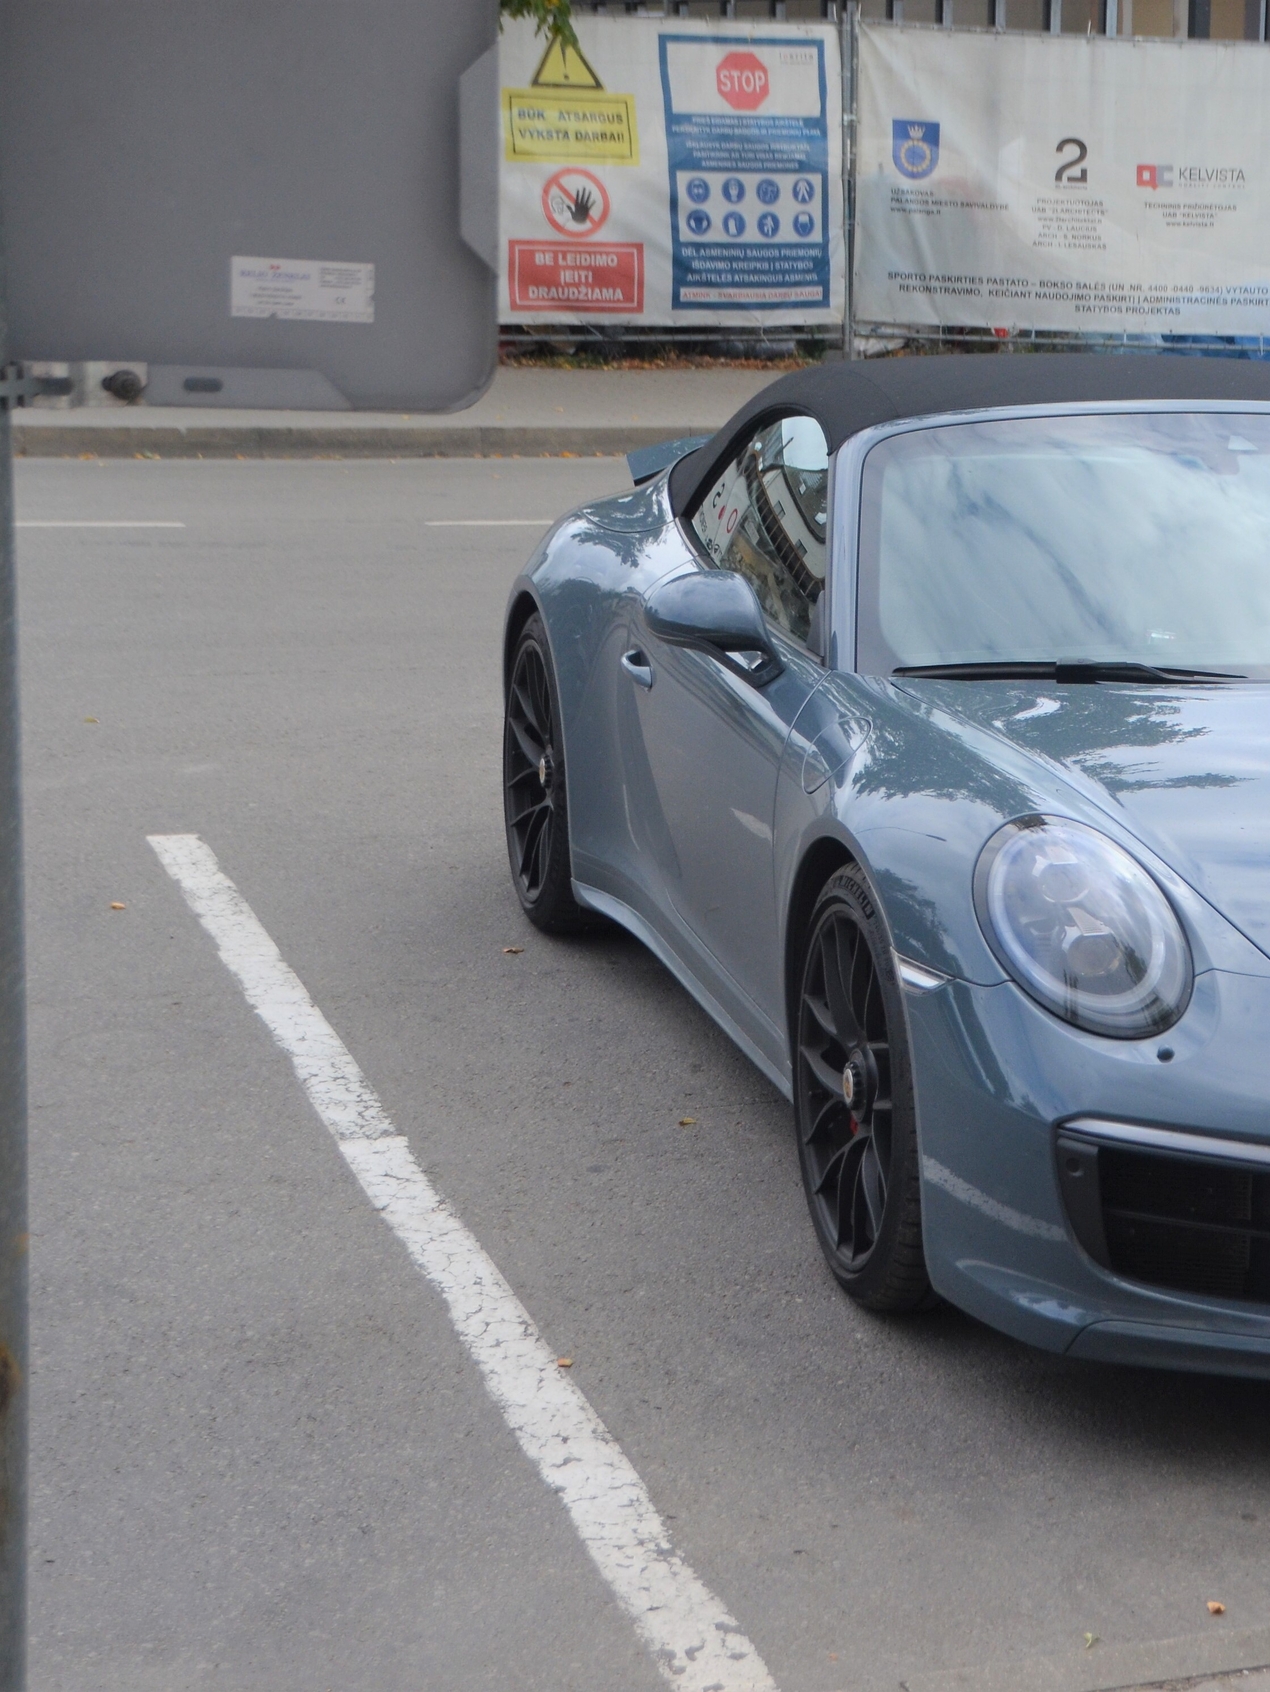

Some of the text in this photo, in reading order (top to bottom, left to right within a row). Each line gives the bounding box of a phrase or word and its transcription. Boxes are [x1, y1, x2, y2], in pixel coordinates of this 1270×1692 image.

[720, 69, 766, 94] STOP
[558, 110, 623, 125] ATSARGUS
[519, 128, 570, 141] VYKSTA
[1178, 167, 1246, 183] KELVISTA
[535, 251, 618, 268] BE LEIDIMO
[746, 248, 780, 258] SAUGOS
[781, 248, 822, 259] PRIEMONIŲ
[691, 259, 731, 270] IŠDAVIMO
[732, 260, 770, 270] KREIPKIS
[775, 260, 814, 270] STATYBOS
[560, 269, 593, 286] ĮEITI
[734, 272, 783, 283] ATSAKINGUS
[887, 271, 927, 282] SPORTO
[928, 273, 984, 285] PASKIRTIES
[986, 277, 1029, 288] PASTATO
[1039, 279, 1073, 290] BOKSO
[1075, 280, 1106, 292] SALĖS
[1226, 286, 1269, 296] VYTAUTO
[528, 285, 624, 302] DRAUDŽIAMA
[898, 284, 983, 298] REKONSTRAVIMO,
[988, 286, 1032, 299] KEIČIANT
[1034, 290, 1091, 301] NAUDOJIMO
[1093, 293, 1136, 305] PASKIRTĮ
[1142, 295, 1228, 306] ADMINISTRACINĖS
[1074, 304, 1181, 316] STATYBOS PROJEKTAS
